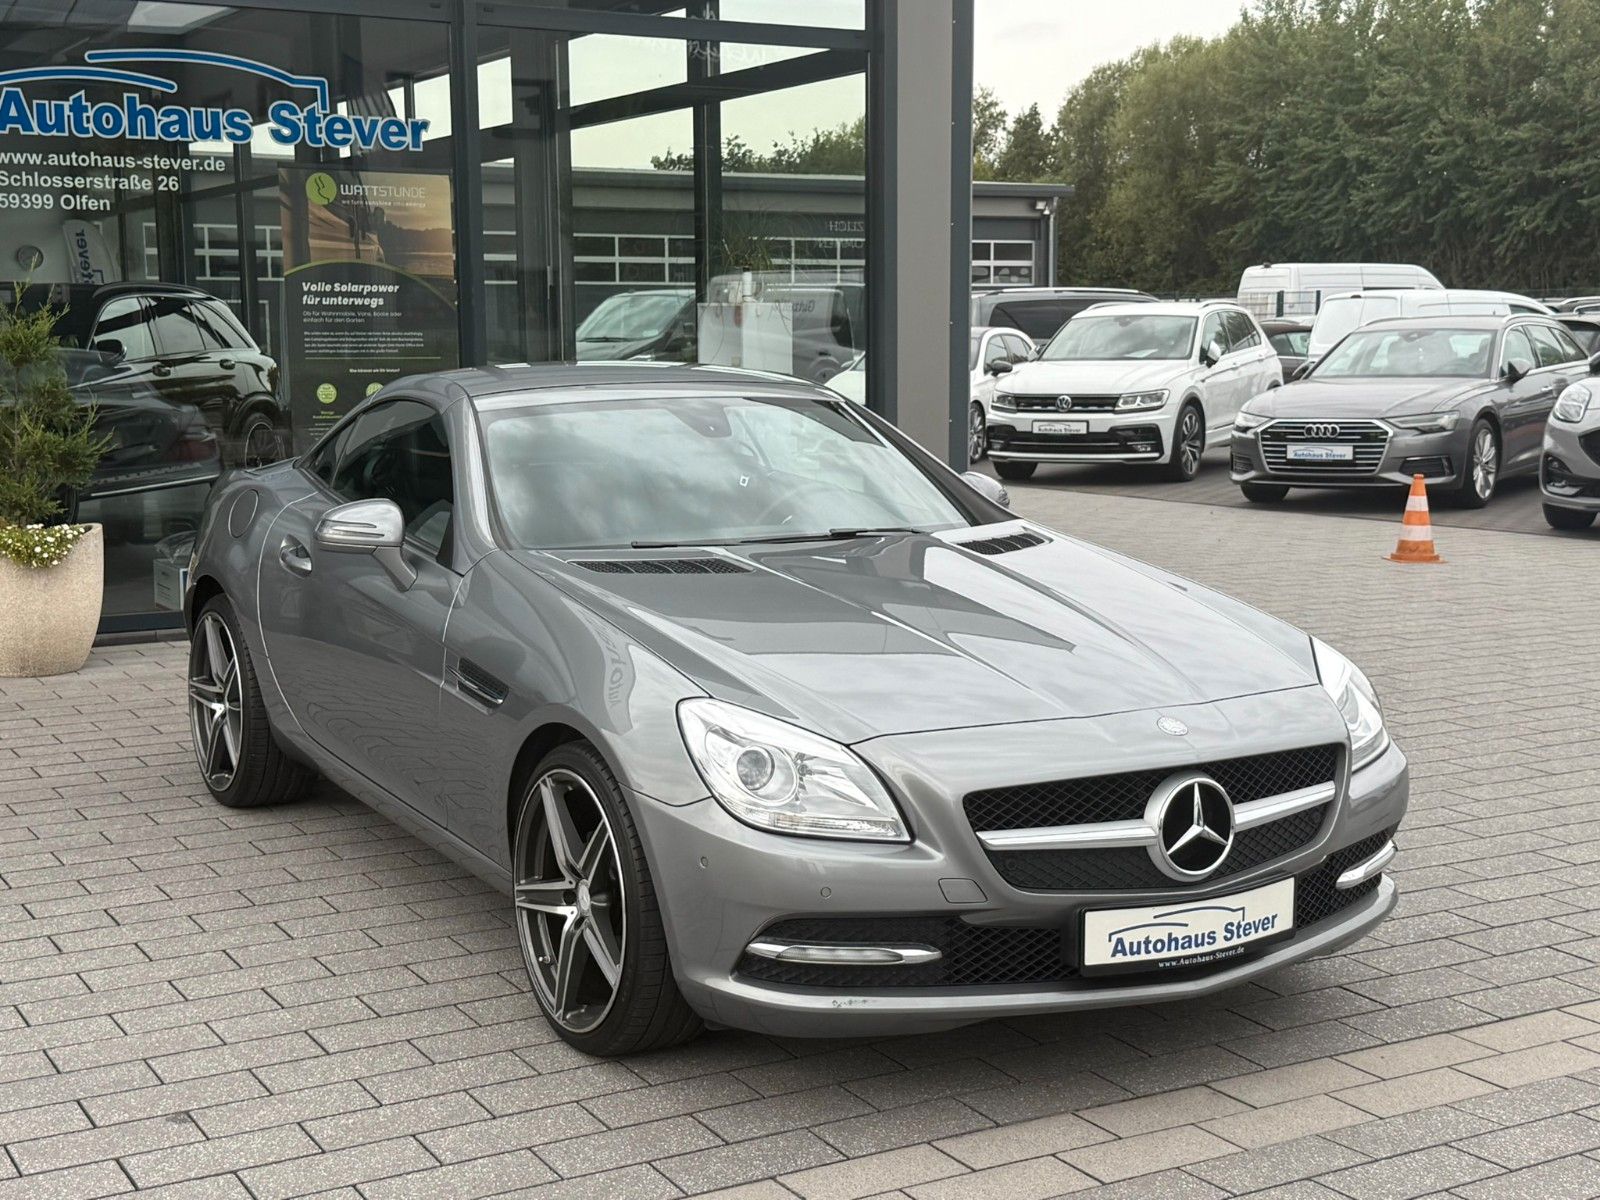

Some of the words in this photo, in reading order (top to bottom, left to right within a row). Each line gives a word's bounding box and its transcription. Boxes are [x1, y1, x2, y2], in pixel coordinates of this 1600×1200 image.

[0, 87, 253, 144] Autohaus
[268, 100, 431, 151] Stever
[0, 151, 226, 172] www.autohaus-stever.de
[0, 170, 152, 191] Schlosserstraße
[157, 175, 180, 191] 26
[0, 193, 54, 209] 59399
[60, 195, 111, 211] Olfen
[340, 184, 426, 199] WATTSTUNDE
[302, 282, 332, 292] Volle
[333, 282, 400, 296] Solarpower
[302, 294, 321, 305] für
[322, 296, 384, 308] unterwegs
[1110, 930, 1217, 958] Autohaus
[1223, 913, 1278, 942] Stever
[1158, 945, 1245, 968] www.Autohaus-Stever.de
